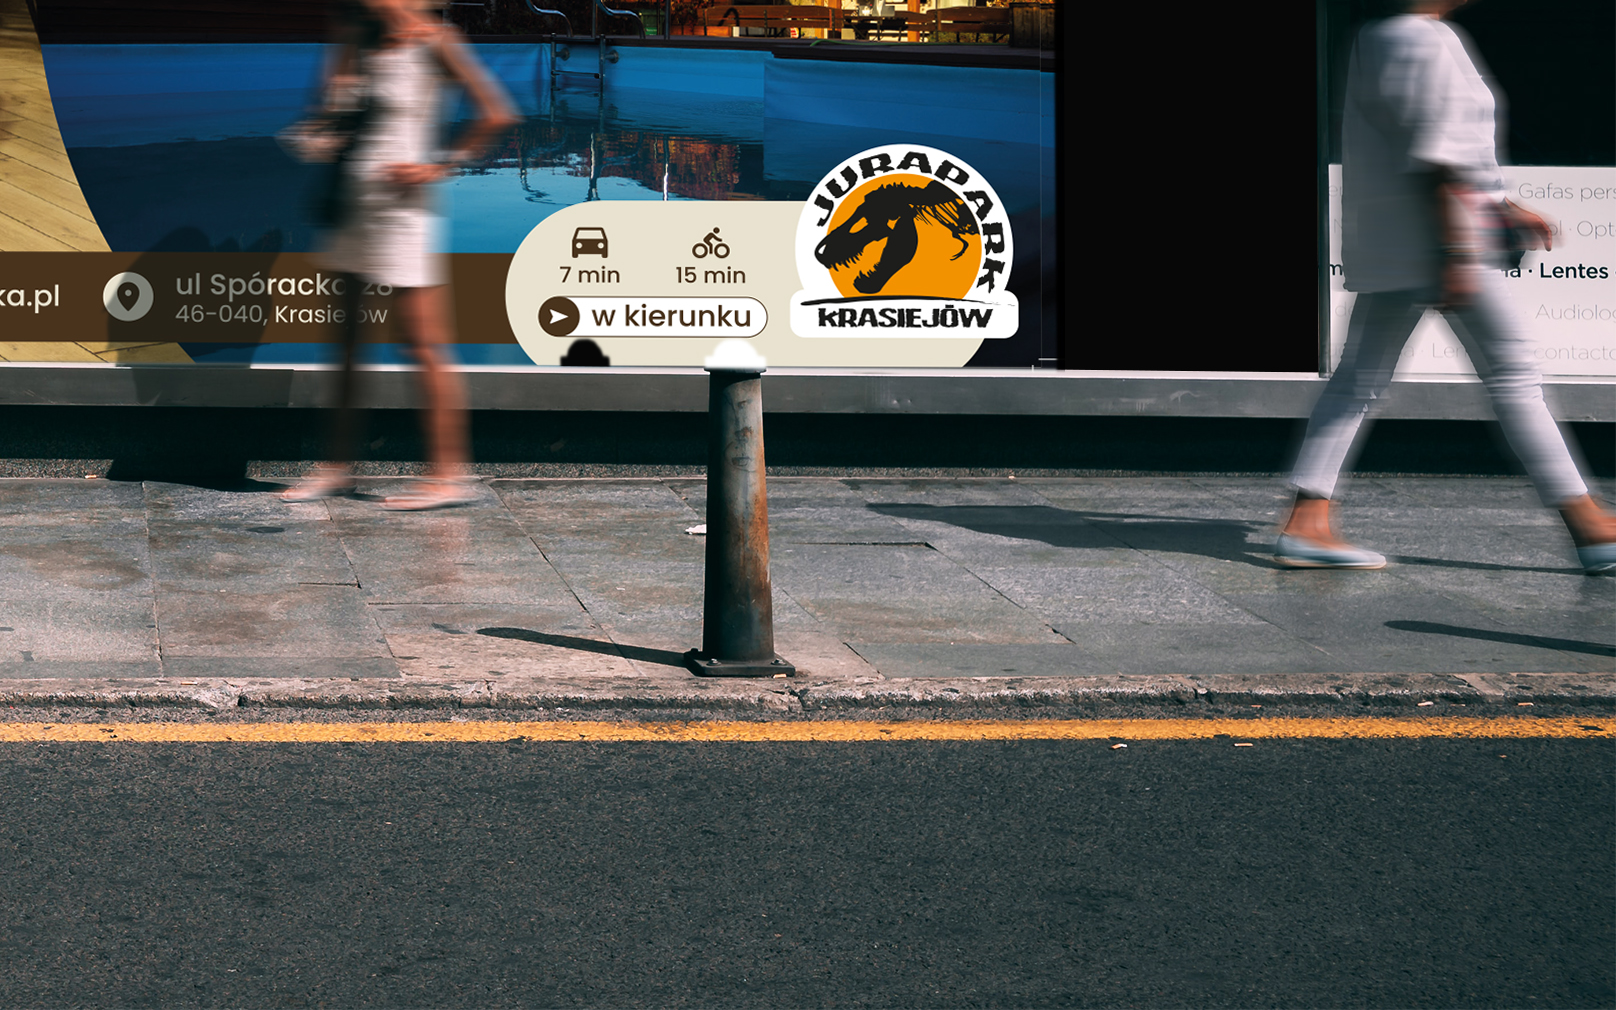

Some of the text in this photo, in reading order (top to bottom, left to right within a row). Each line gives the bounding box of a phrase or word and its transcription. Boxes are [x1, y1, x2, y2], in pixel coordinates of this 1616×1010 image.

[1518, 182, 1574, 200] Gafas
[813, 151, 1006, 294] JURAPARK
[1576, 220, 1616, 239] Opt
[559, 265, 620, 284] 7 min
[675, 265, 746, 284] 15 min
[1540, 262, 1609, 279] Lentes
[176, 272, 201, 295] ul
[175, 304, 388, 328] 46-040, Krasieów
[591, 303, 751, 328] w kierunku
